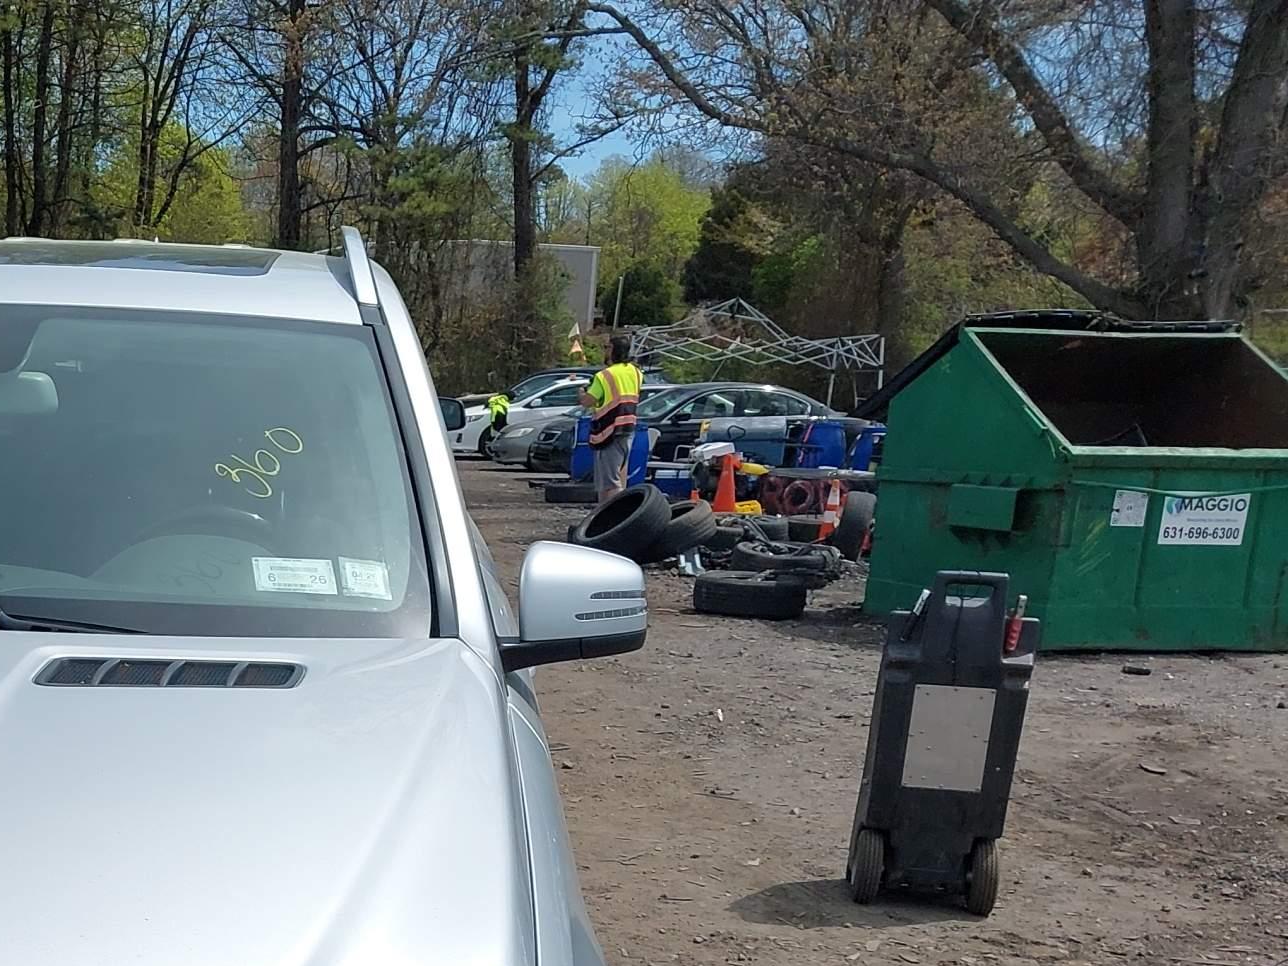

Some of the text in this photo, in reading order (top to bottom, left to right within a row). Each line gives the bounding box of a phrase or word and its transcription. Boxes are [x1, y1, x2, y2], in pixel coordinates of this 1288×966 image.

[214, 426, 303, 498] 360
[1181, 497, 1247, 512] MAGGIO
[1163, 526, 1240, 540] 631-696-6300
